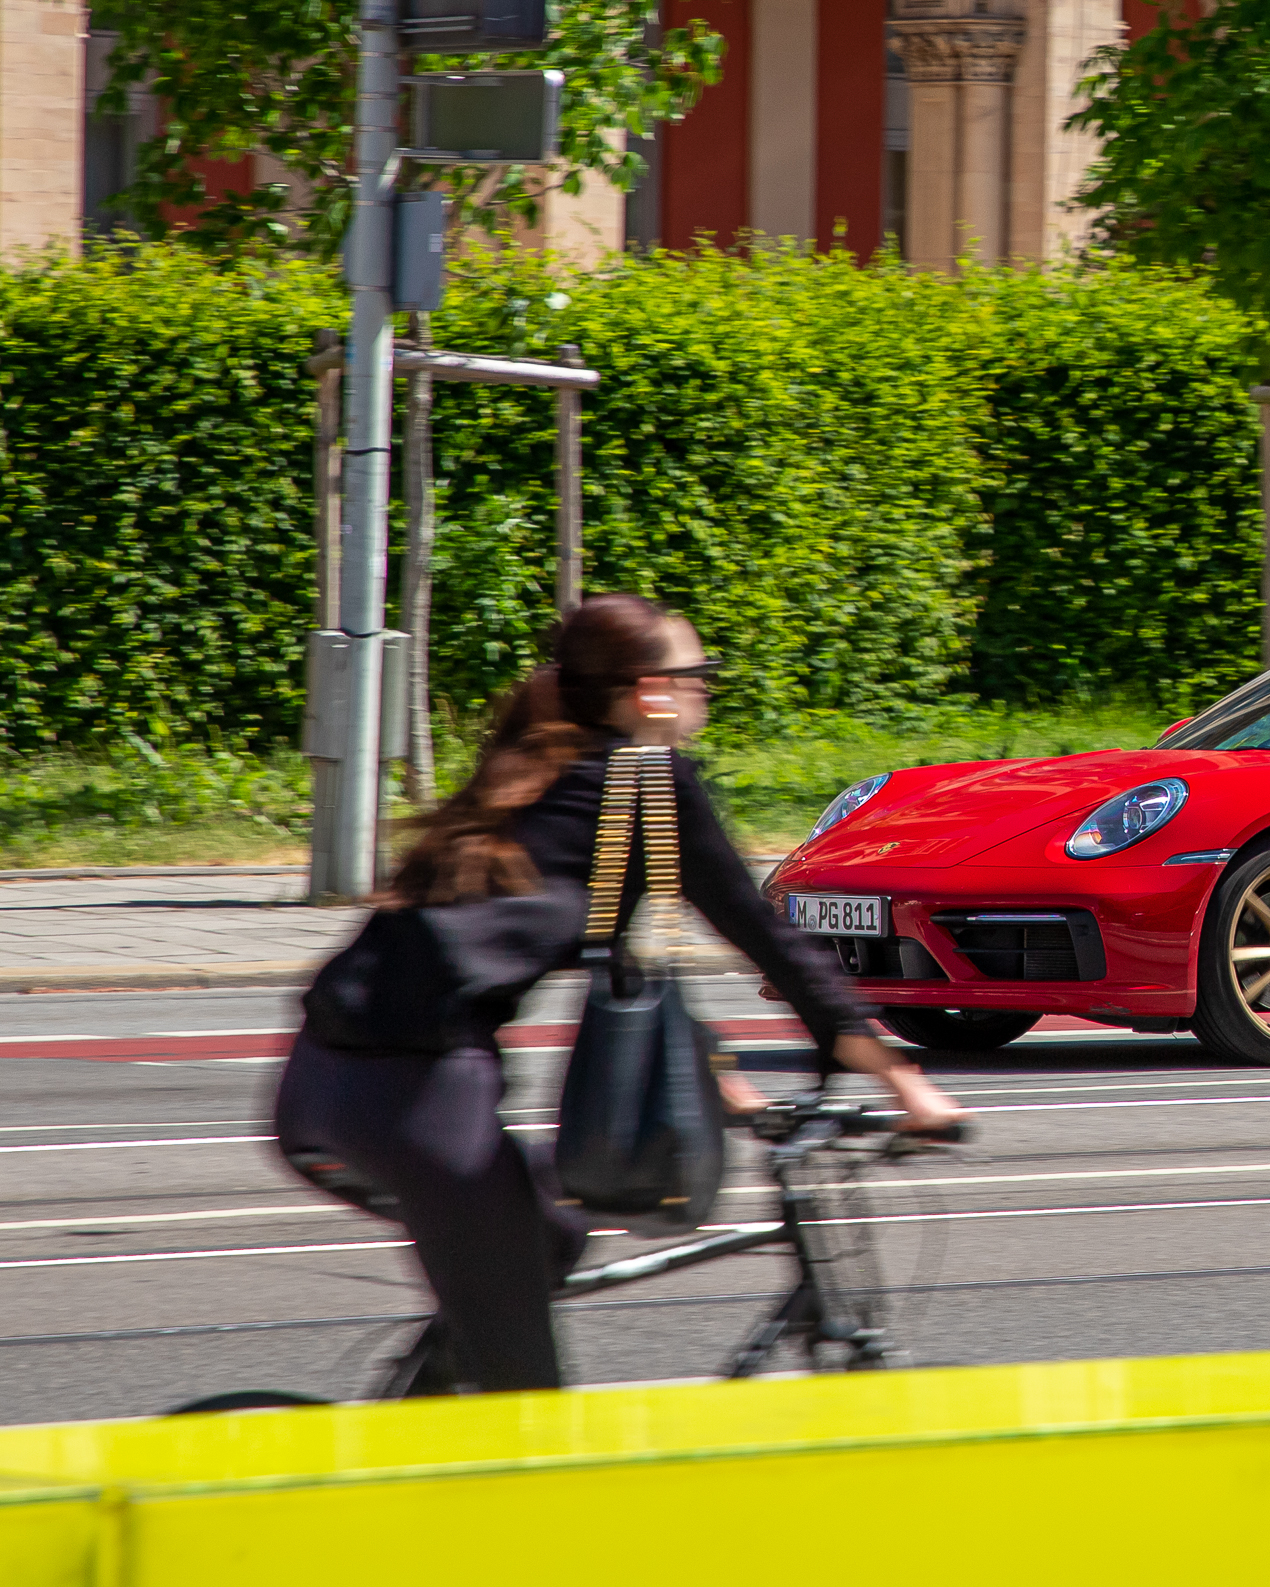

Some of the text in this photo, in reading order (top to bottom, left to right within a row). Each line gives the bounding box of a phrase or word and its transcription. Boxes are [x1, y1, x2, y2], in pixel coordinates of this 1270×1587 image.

[797, 901, 877, 930] M PG 811
